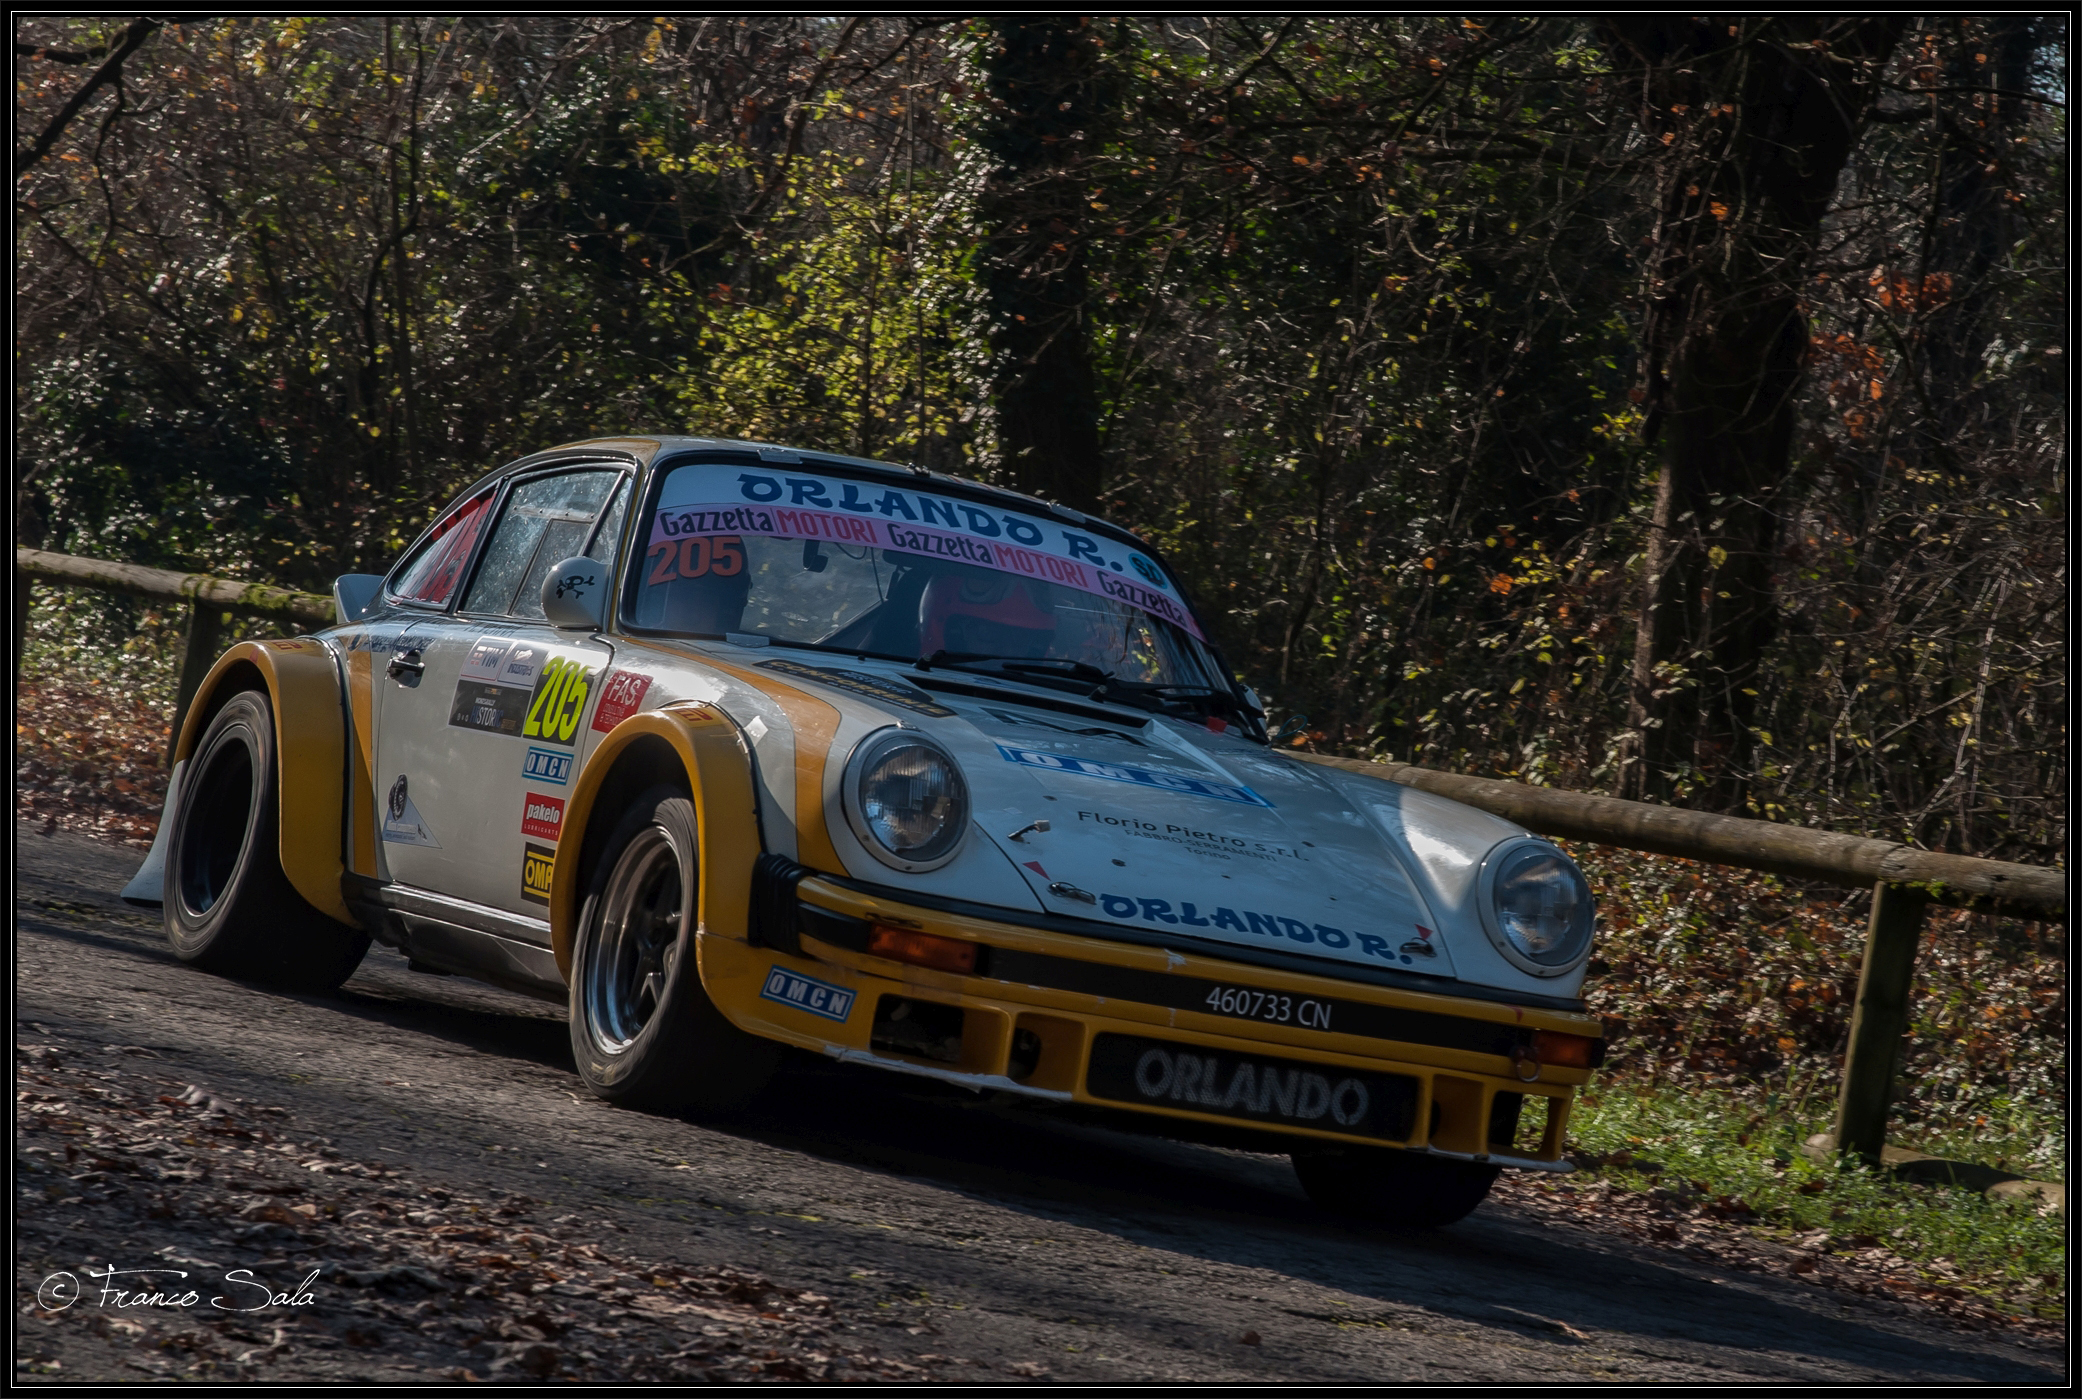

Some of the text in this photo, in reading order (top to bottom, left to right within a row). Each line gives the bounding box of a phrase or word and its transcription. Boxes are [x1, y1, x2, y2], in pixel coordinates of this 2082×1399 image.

[737, 473, 1123, 573] ORLANDO R.
[647, 536, 743, 586] 205
[659, 508, 775, 537] Gazzetta
[776, 509, 878, 544] MOTORI
[887, 523, 993, 565] Gazzetta
[993, 543, 1089, 588] MOTORI
[1096, 570, 1189, 629] Gazzetta
[523, 655, 588, 741] 205
[526, 753, 569, 778] OMCN
[1020, 752, 1243, 800] OMCN
[525, 803, 561, 824] pakelo
[1078, 810, 1310, 862] Florio Pietro s.r.l.
[1125, 828, 1278, 863] FABBRO-SERRAMENTI
[1184, 846, 1232, 861] Torino
[524, 859, 554, 891] OMP
[1100, 893, 1413, 965] ORLANDO R.
[768, 974, 847, 1015] OMCN
[1205, 986, 1332, 1030] 460733 CN
[1134, 1048, 1370, 1127] ORLANDO
